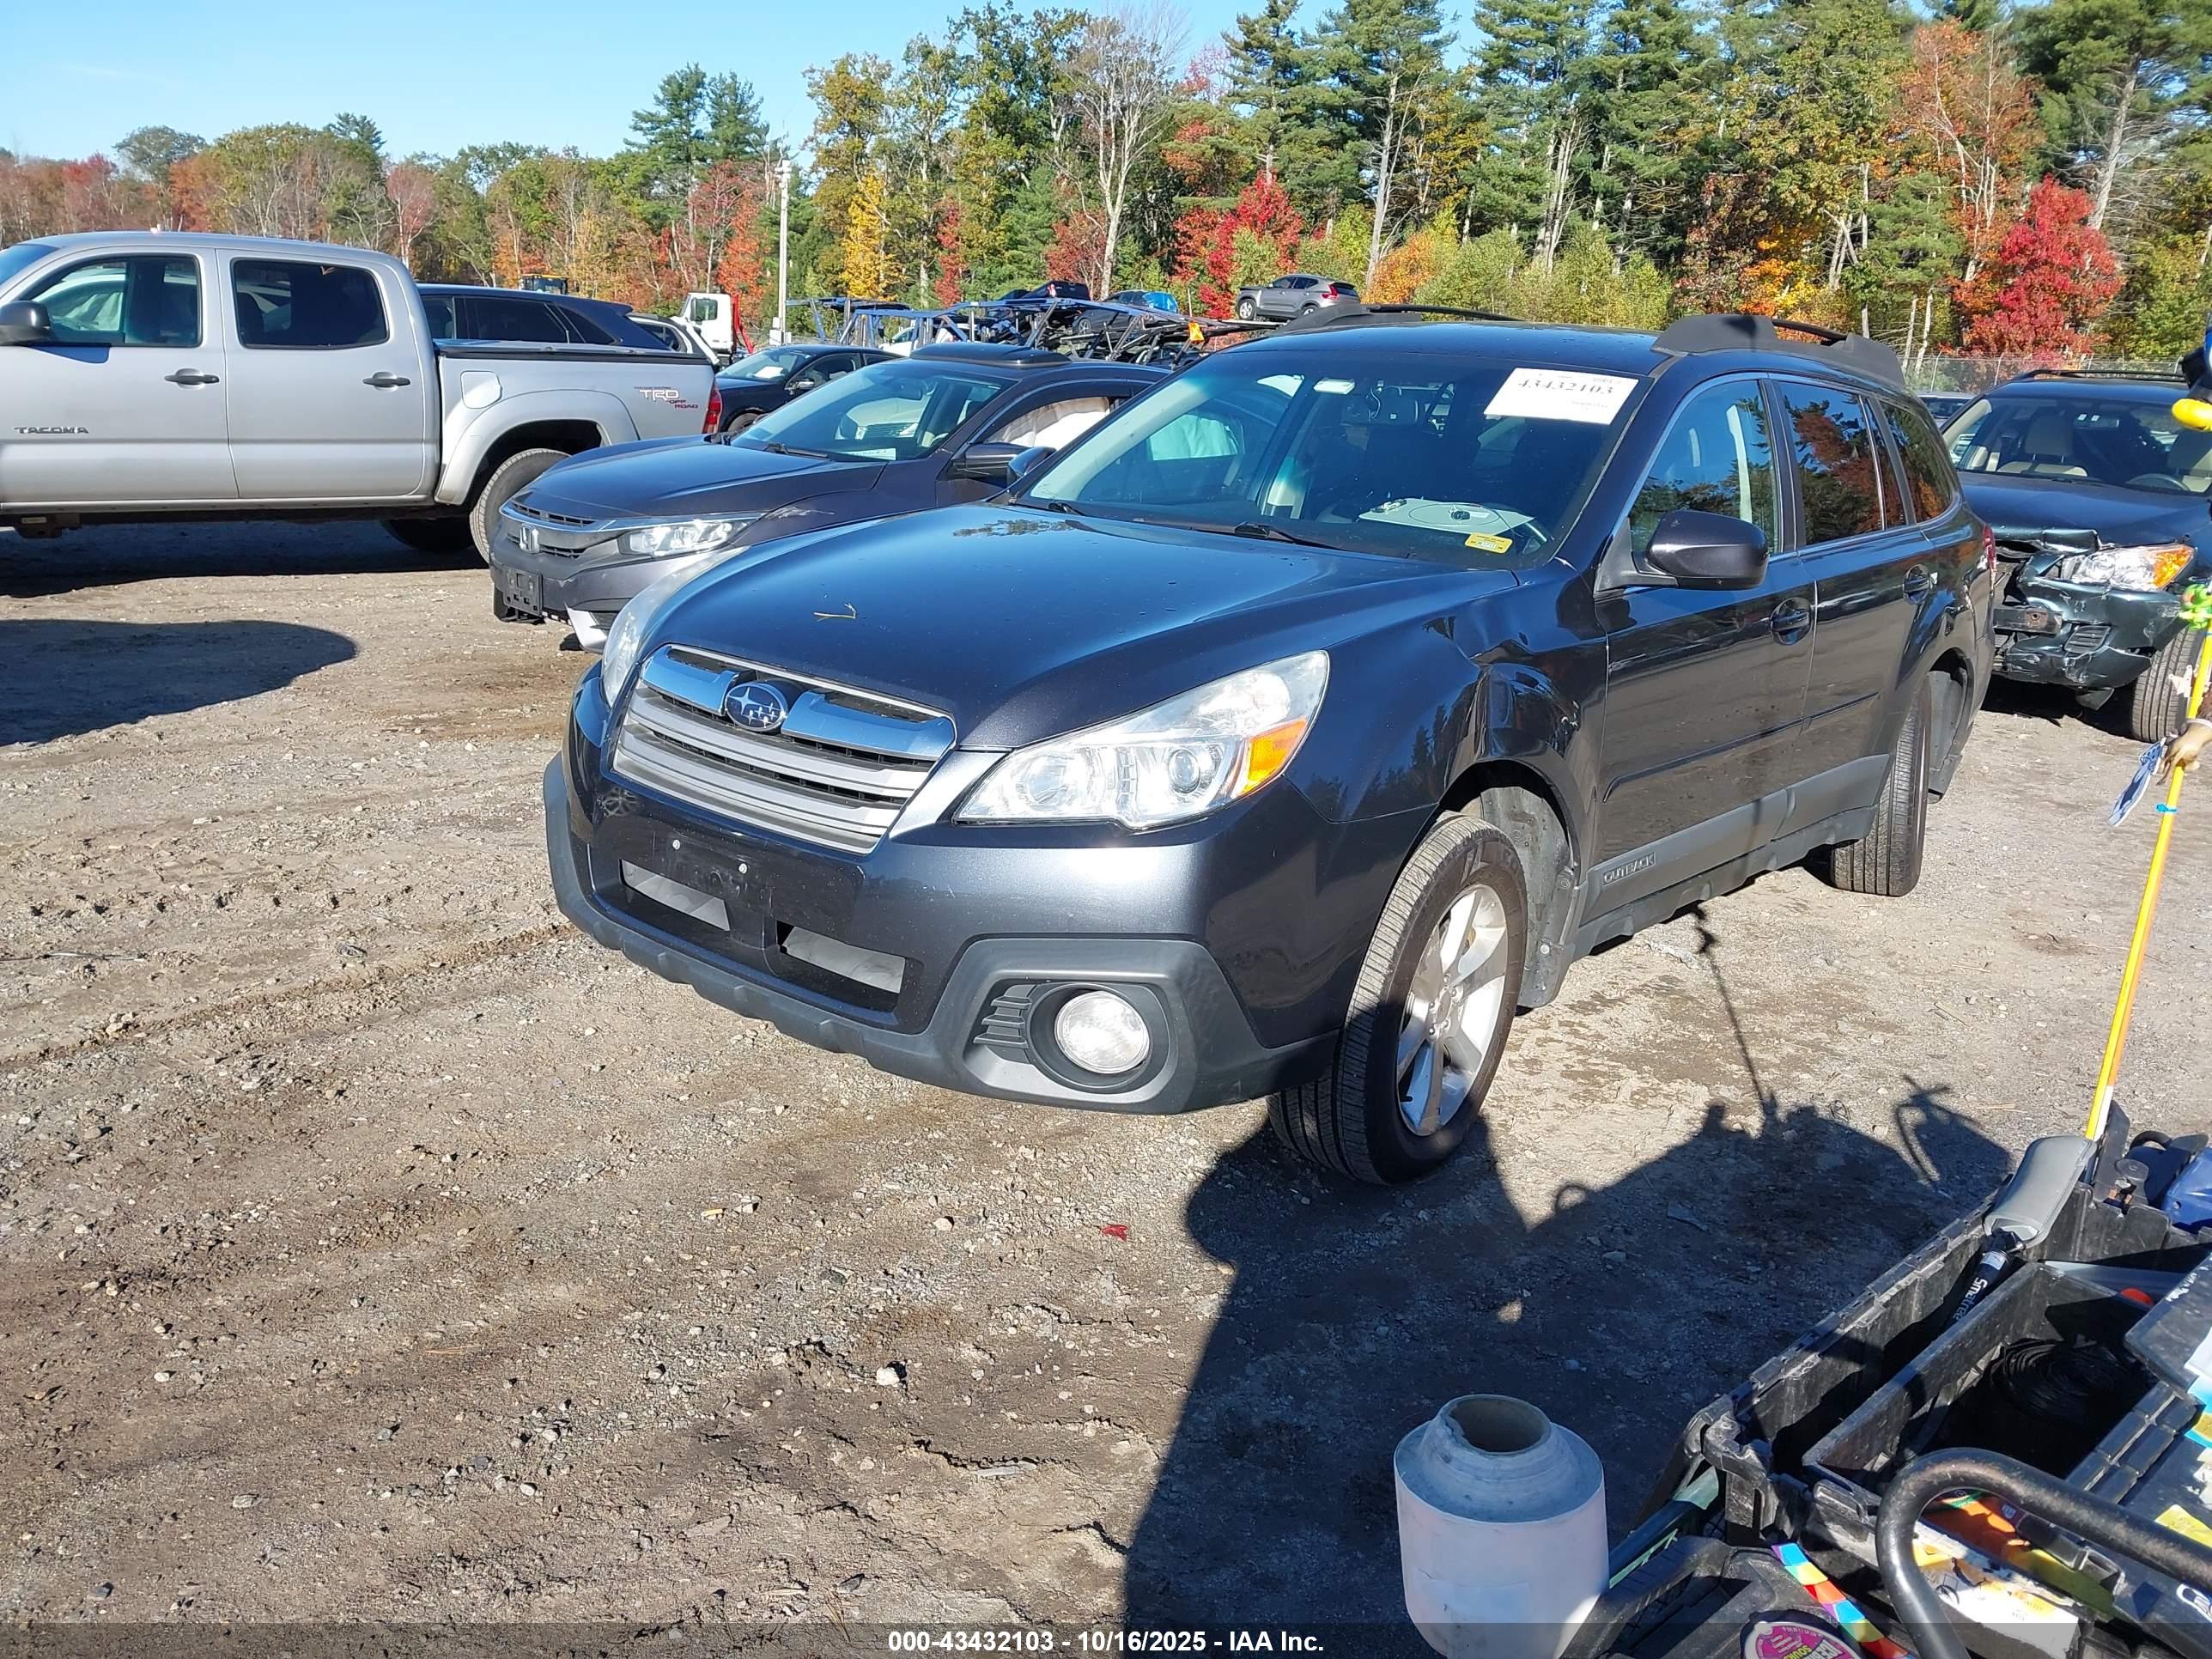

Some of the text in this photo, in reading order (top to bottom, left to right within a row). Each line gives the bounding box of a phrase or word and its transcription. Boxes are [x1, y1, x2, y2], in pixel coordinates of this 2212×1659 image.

[639, 389, 680, 402] TRD
[1518, 378, 1614, 395] 43432103
[1603, 853, 1656, 884] OUTBACK
[1952, 1276, 1989, 1321] Smatree
